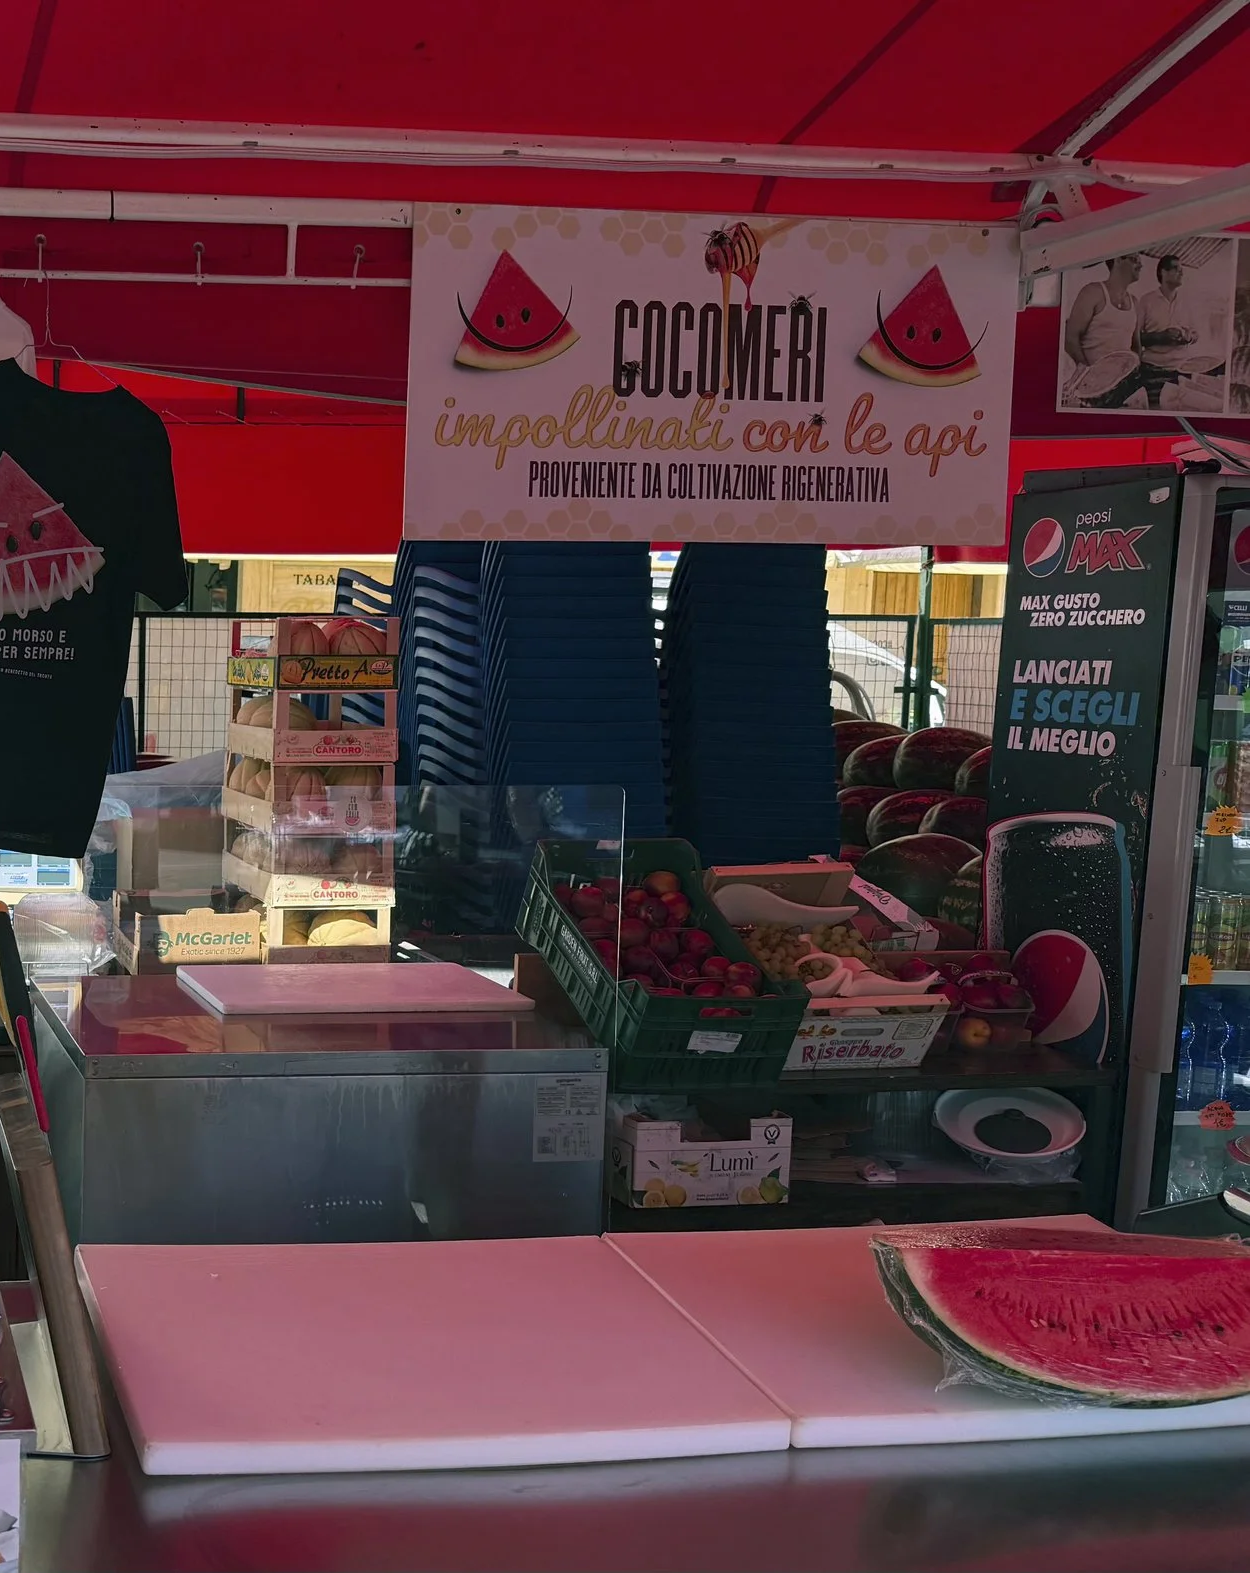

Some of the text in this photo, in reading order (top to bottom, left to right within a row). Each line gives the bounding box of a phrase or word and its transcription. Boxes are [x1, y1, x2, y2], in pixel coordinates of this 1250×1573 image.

[613, 299, 828, 402] COCOMERI
[434, 384, 987, 478] impollinati con le api
[528, 460, 891, 503] PROVENIENTE DA COLTIVAZIONE RIGENERATIVA
[1076, 508, 1112, 528] pepsi
[1065, 524, 1154, 576] MAX
[293, 574, 336, 586] TABA
[1020, 592, 1101, 611] MAX GUSTO
[1030, 608, 1146, 627] ZERO ZUCCHERO
[12, 628, 54, 642] MORSO
[59, 630, 66, 643] E
[24, 646, 74, 660] SEMPRE!
[297, 657, 350, 683] Pretto
[1012, 660, 1113, 686] LANCIATI
[1010, 689, 1140, 726] E SCEGLI
[316, 745, 362, 754] CANTORO
[1006, 726, 1116, 757] IL MEGLIO
[314, 890, 358, 899] CANTORO
[175, 932, 252, 946] McGariet
[802, 1040, 905, 1064] Riserbato
